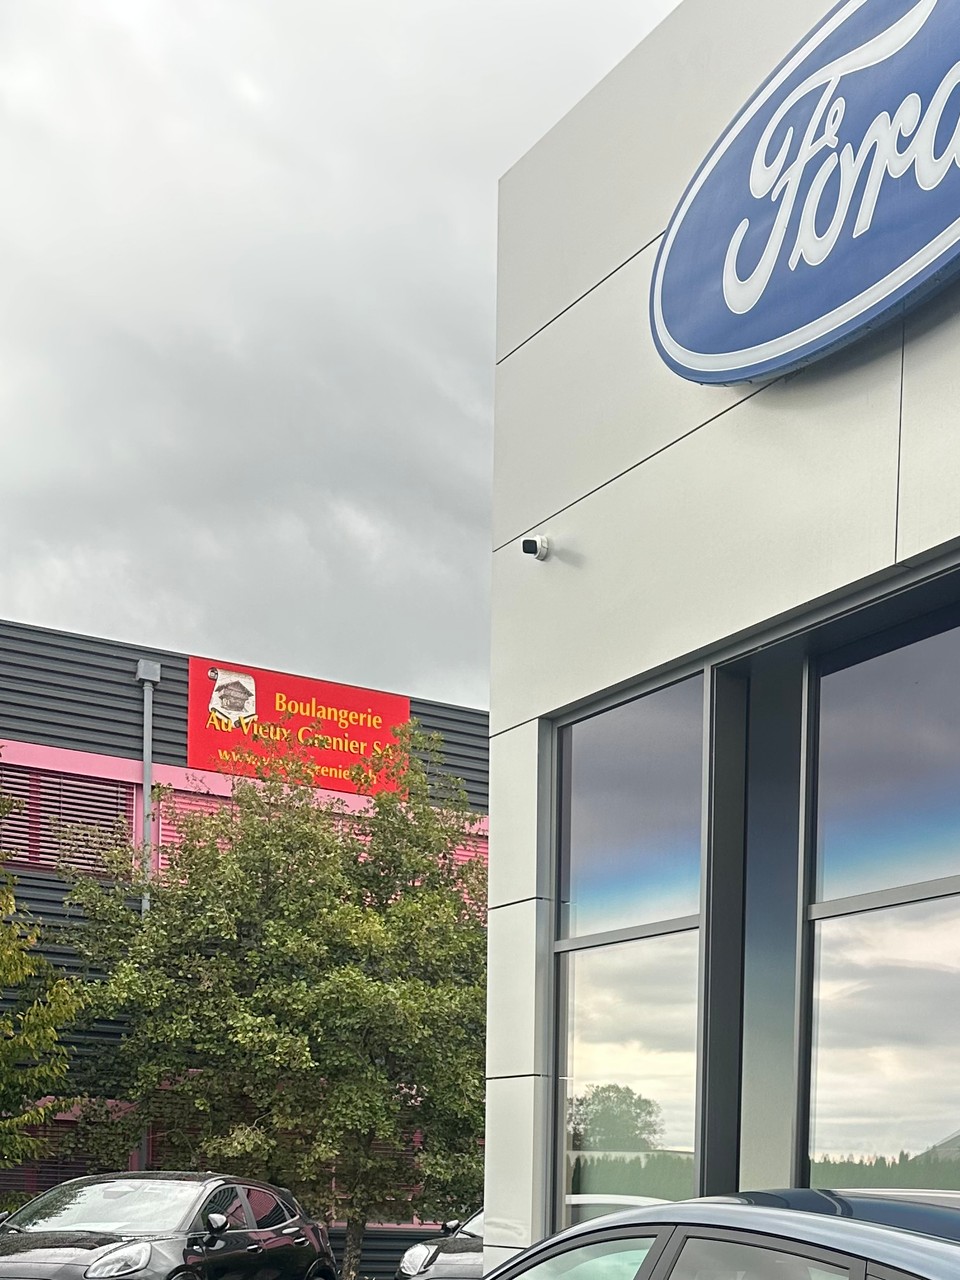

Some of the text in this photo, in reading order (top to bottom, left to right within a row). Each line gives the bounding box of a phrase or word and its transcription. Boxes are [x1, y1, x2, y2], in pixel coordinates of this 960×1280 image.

[275, 692, 383, 729] Boulangerie
[206, 711, 232, 732] Au
[240, 713, 291, 742] Vieux
[297, 726, 367, 755] Grenier
